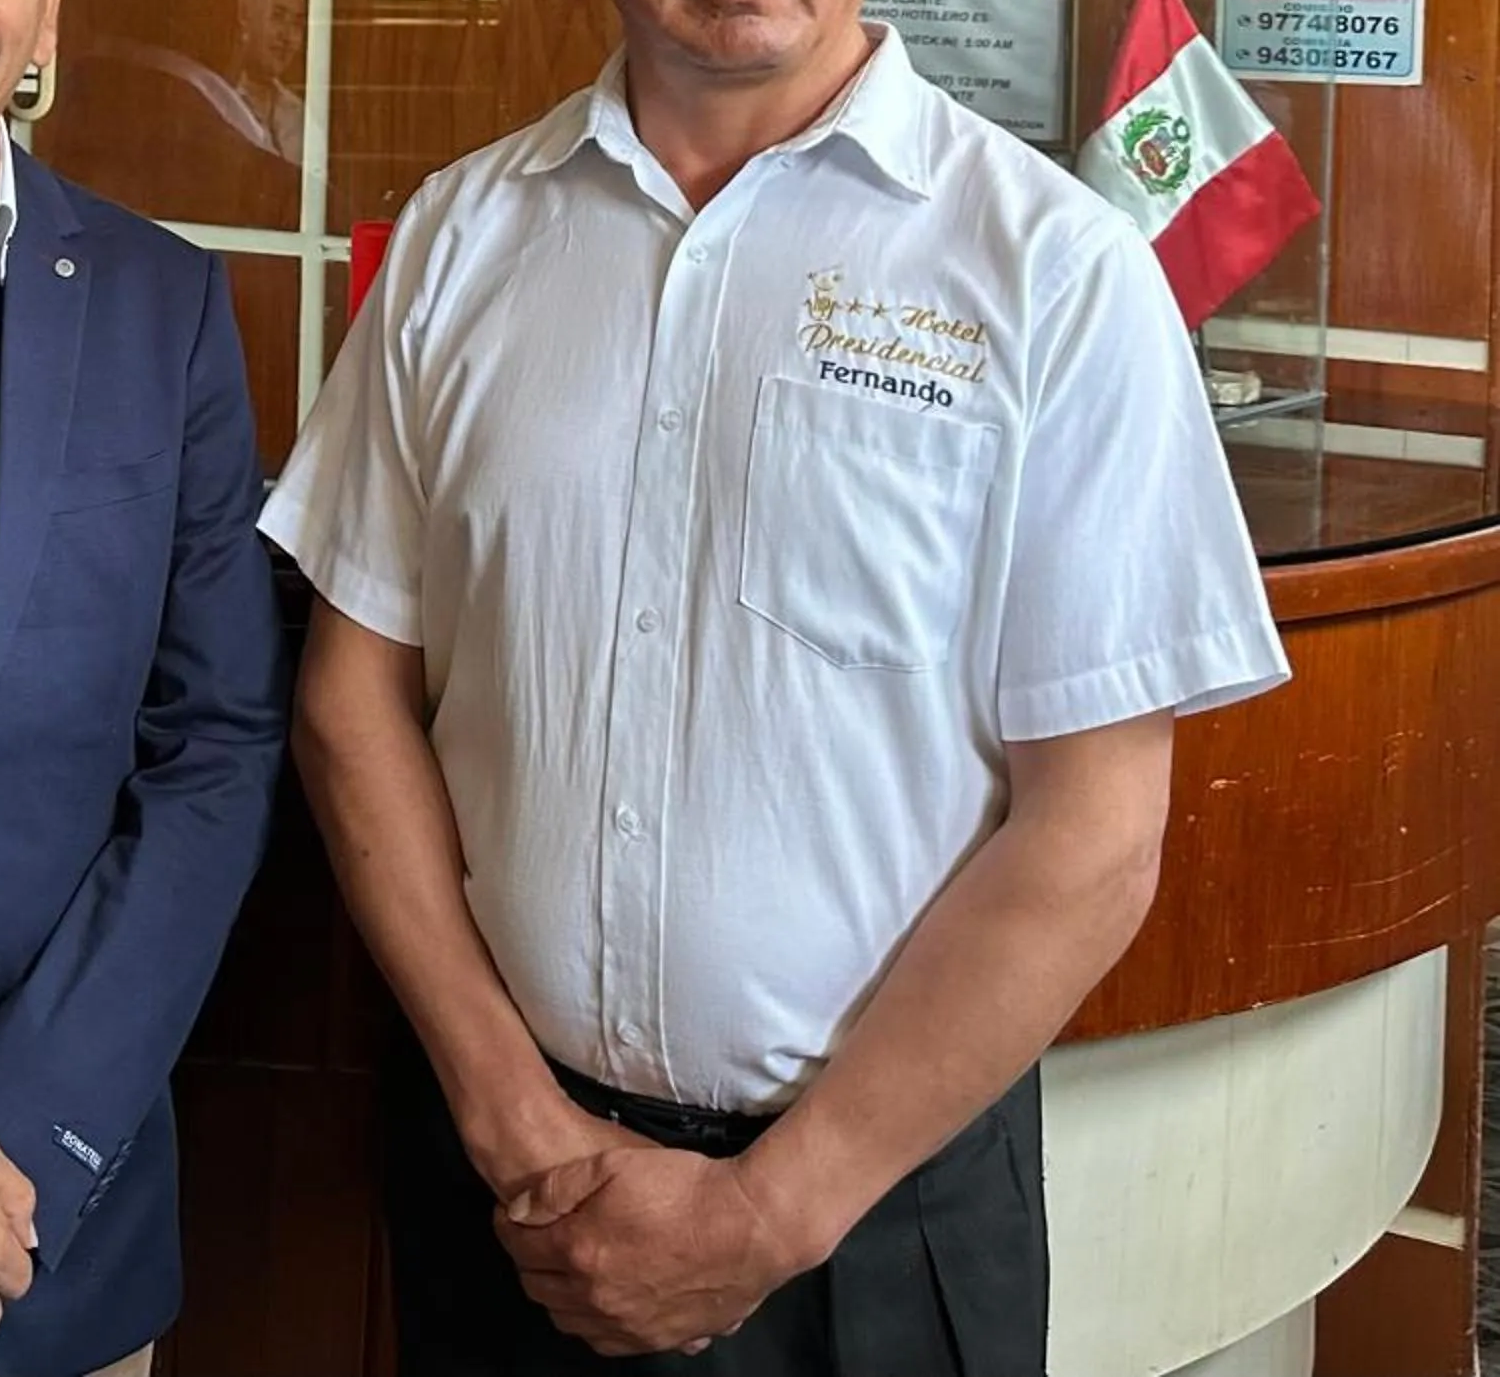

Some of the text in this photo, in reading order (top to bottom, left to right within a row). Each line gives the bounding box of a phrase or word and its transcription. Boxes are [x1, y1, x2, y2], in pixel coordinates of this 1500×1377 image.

[901, 9, 970, 22] HOTELERO
[993, 38, 1013, 49] AM
[991, 79, 1011, 89] PM
[900, 305, 986, 345] Hotel
[798, 323, 985, 384] Presidencial
[820, 360, 953, 408] Fernando
